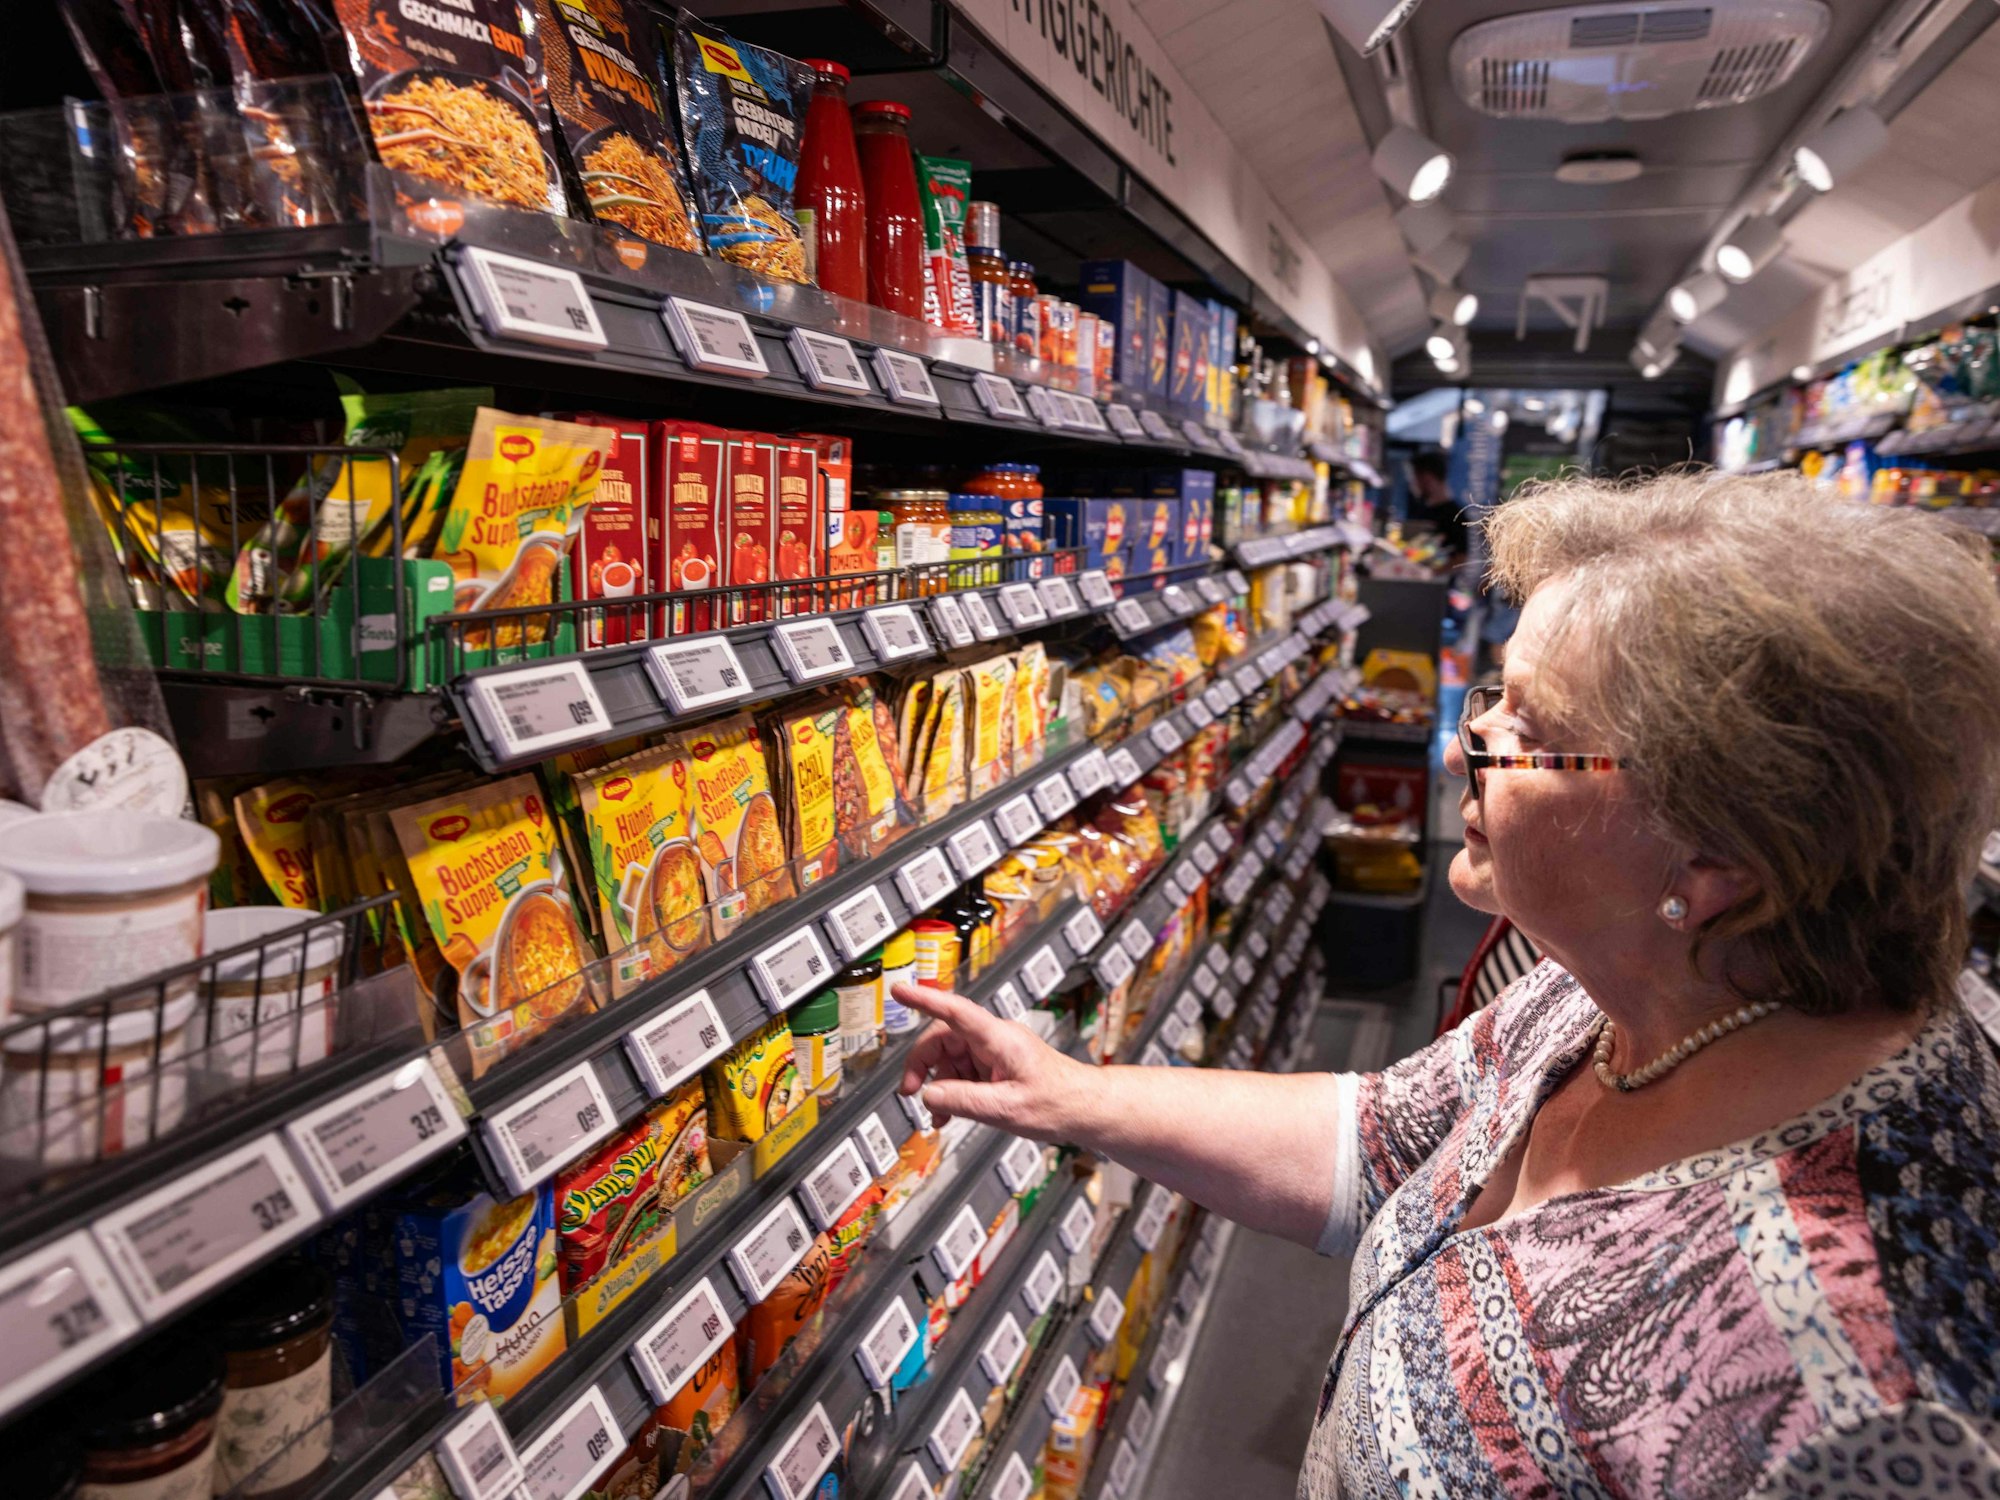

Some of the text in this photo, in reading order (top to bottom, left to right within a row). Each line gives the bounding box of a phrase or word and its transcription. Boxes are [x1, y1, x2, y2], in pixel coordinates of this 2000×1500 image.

[436, 831, 532, 896] Buchstaben
[445, 882, 499, 924] Suppe
[468, 1225, 537, 1300] Heisse
[479, 1251, 533, 1313] Tasse
[587, 1428, 610, 1461] 0.99
